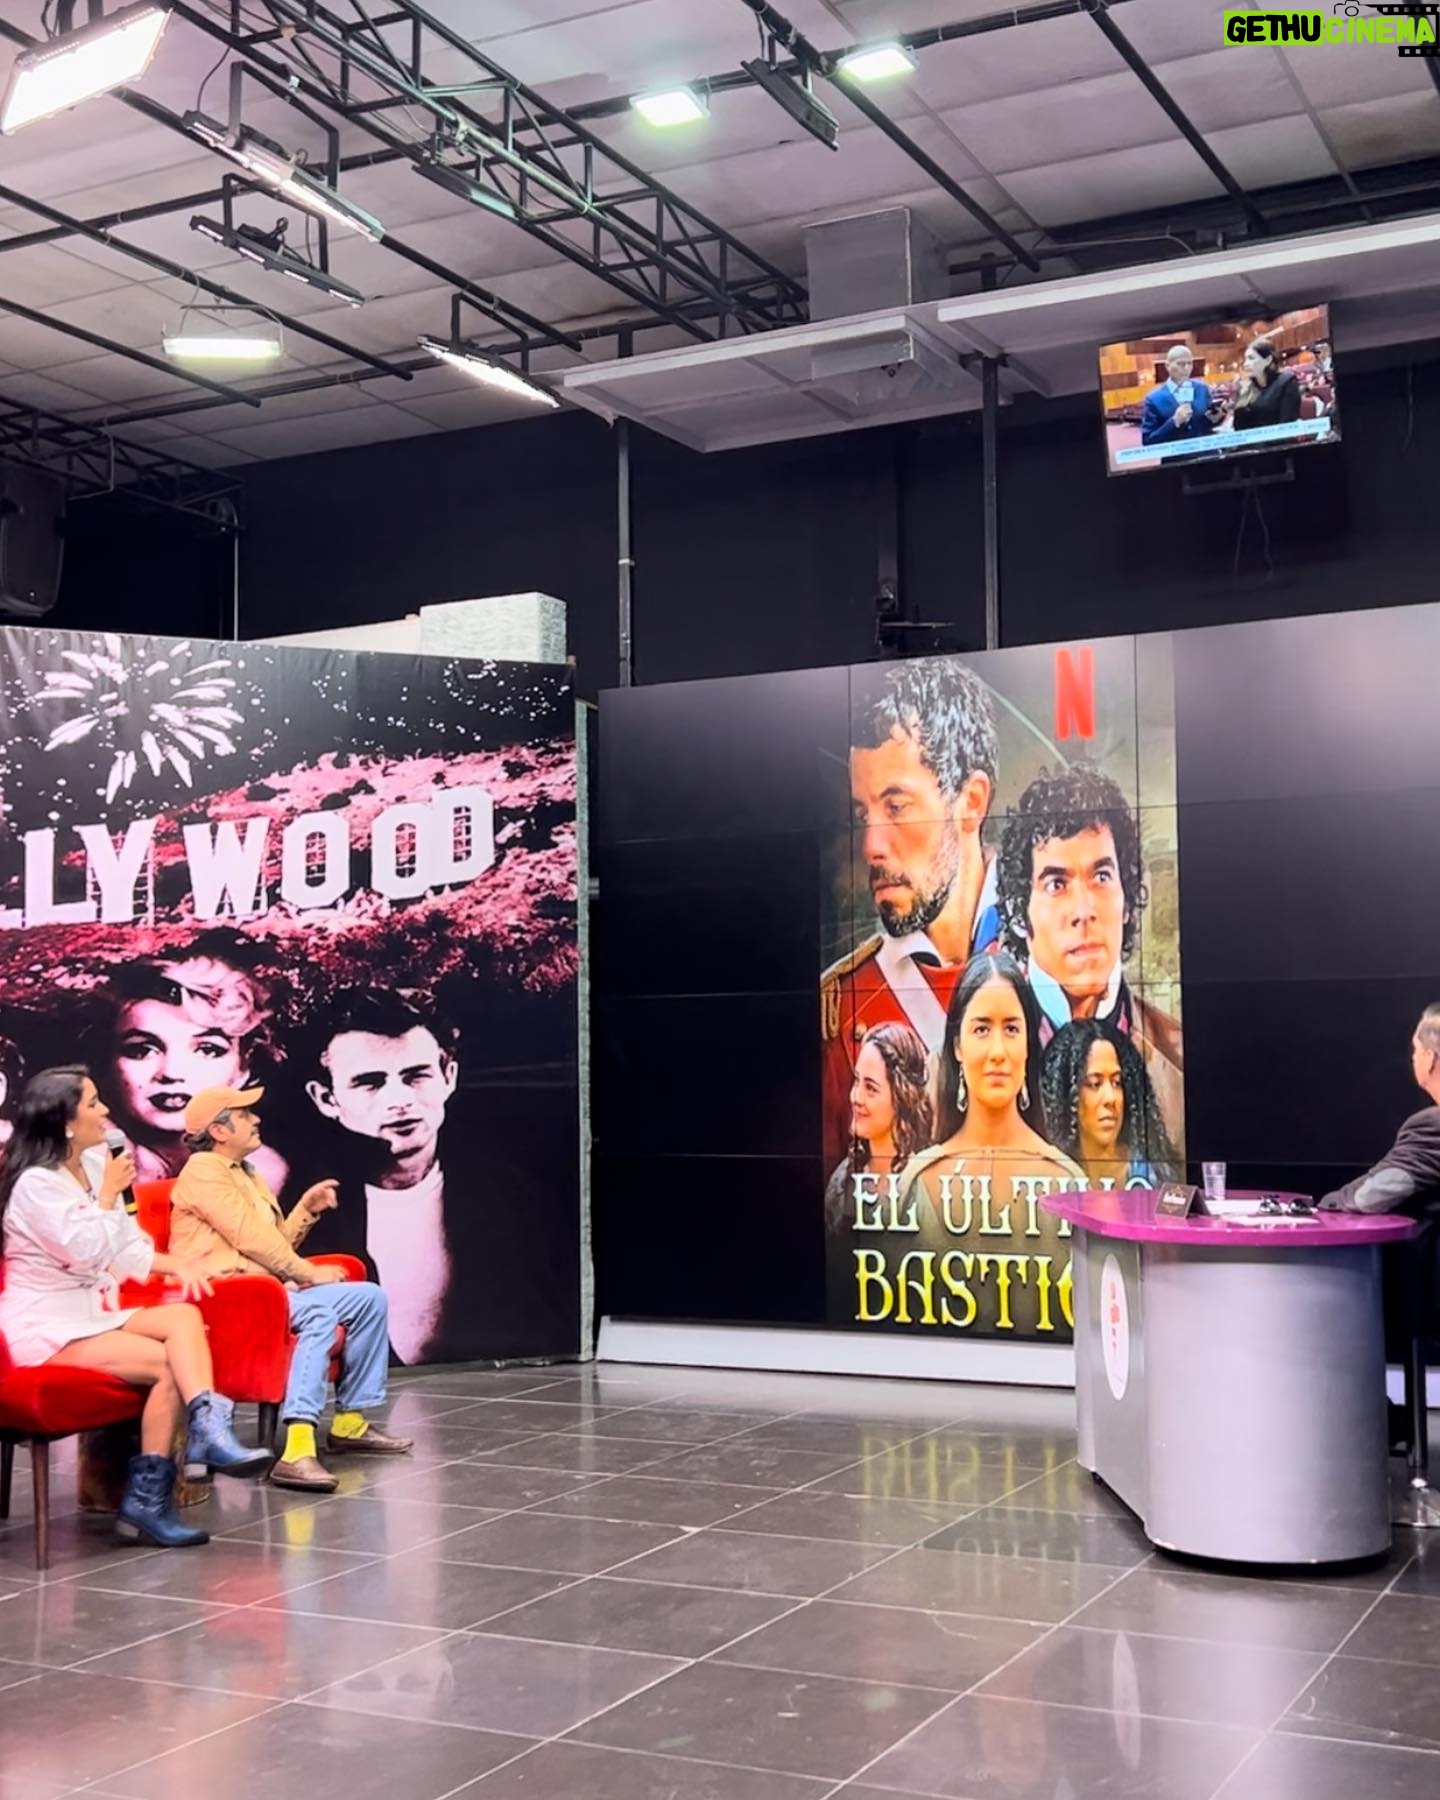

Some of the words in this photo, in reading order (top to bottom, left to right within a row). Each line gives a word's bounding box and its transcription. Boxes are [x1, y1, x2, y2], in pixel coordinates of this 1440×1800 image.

[1055, 646, 1095, 740] N
[851, 1173, 919, 1232] EL
[939, 1159, 1153, 1237] ÚLTI
